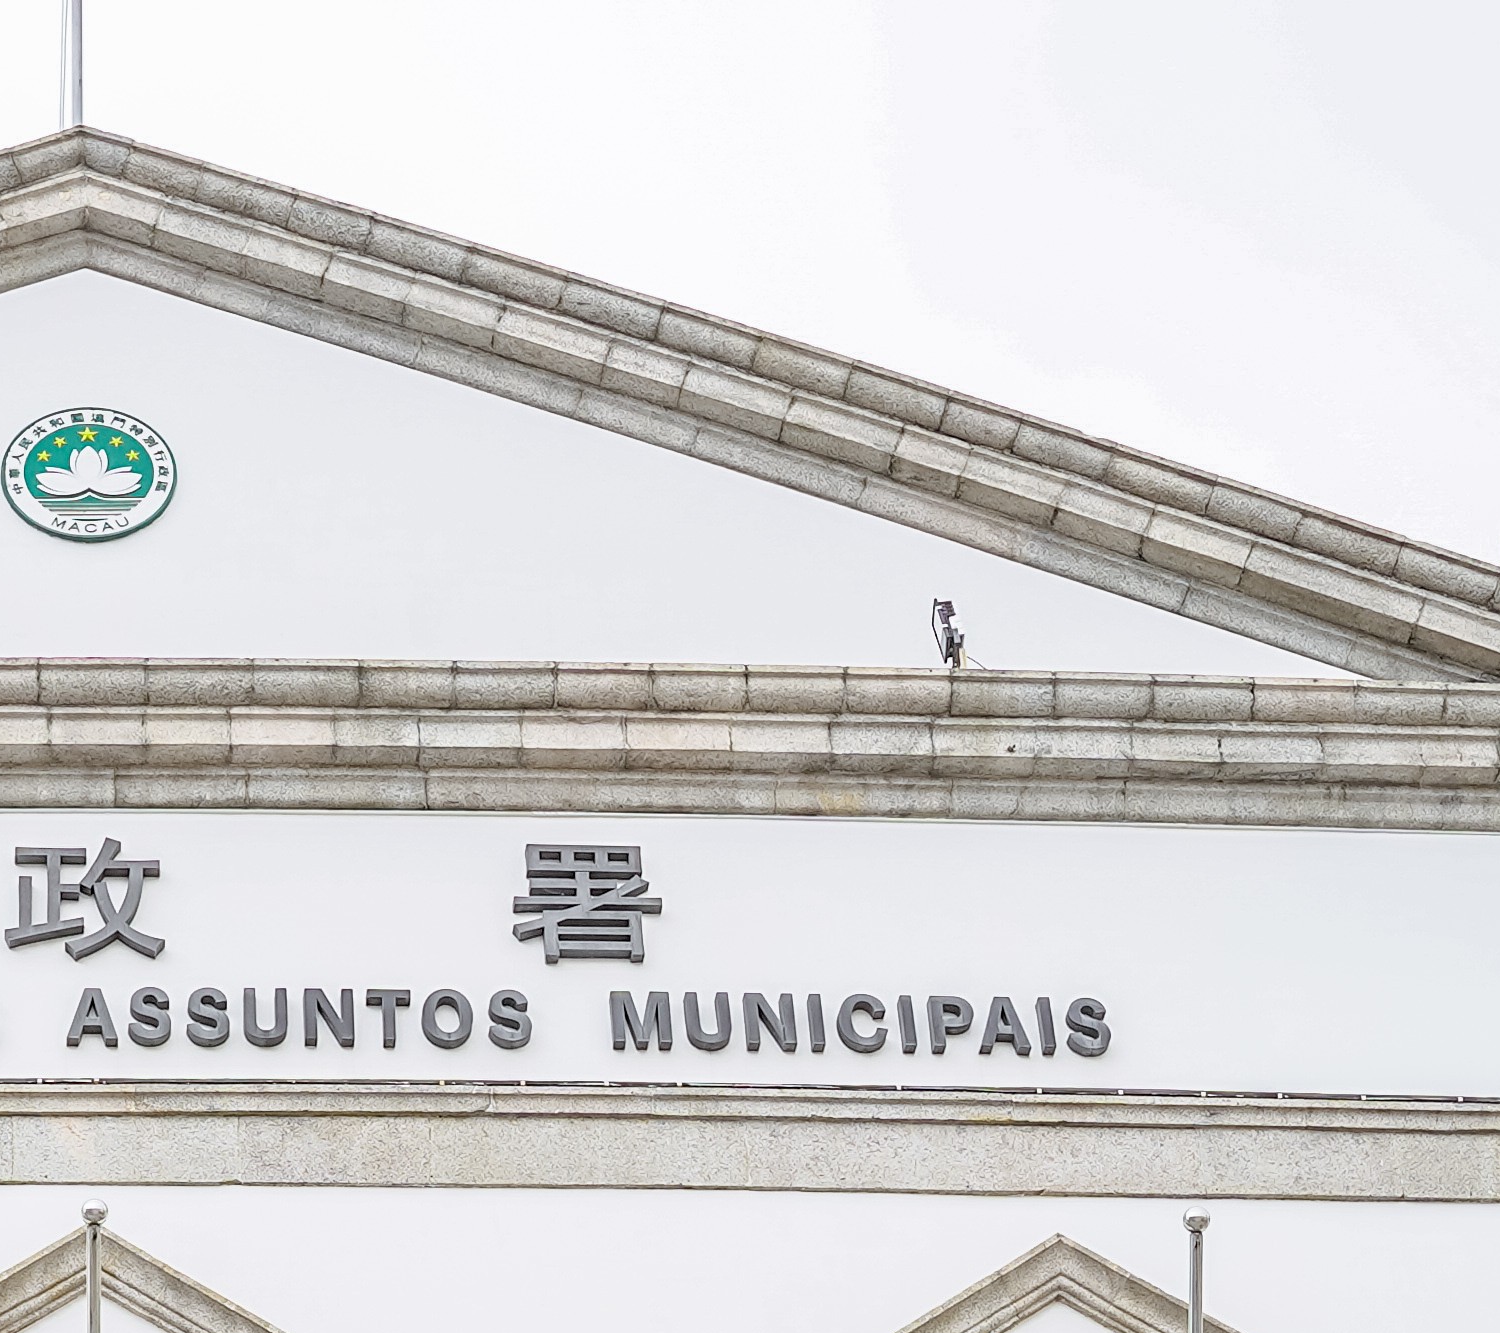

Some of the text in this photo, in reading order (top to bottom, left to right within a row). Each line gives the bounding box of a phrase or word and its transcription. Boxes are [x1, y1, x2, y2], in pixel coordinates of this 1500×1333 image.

[51, 516, 130, 533] MACAU
[65, 985, 534, 1051] ASSUNTOS
[608, 989, 1113, 1058] MUNICIPAIS
